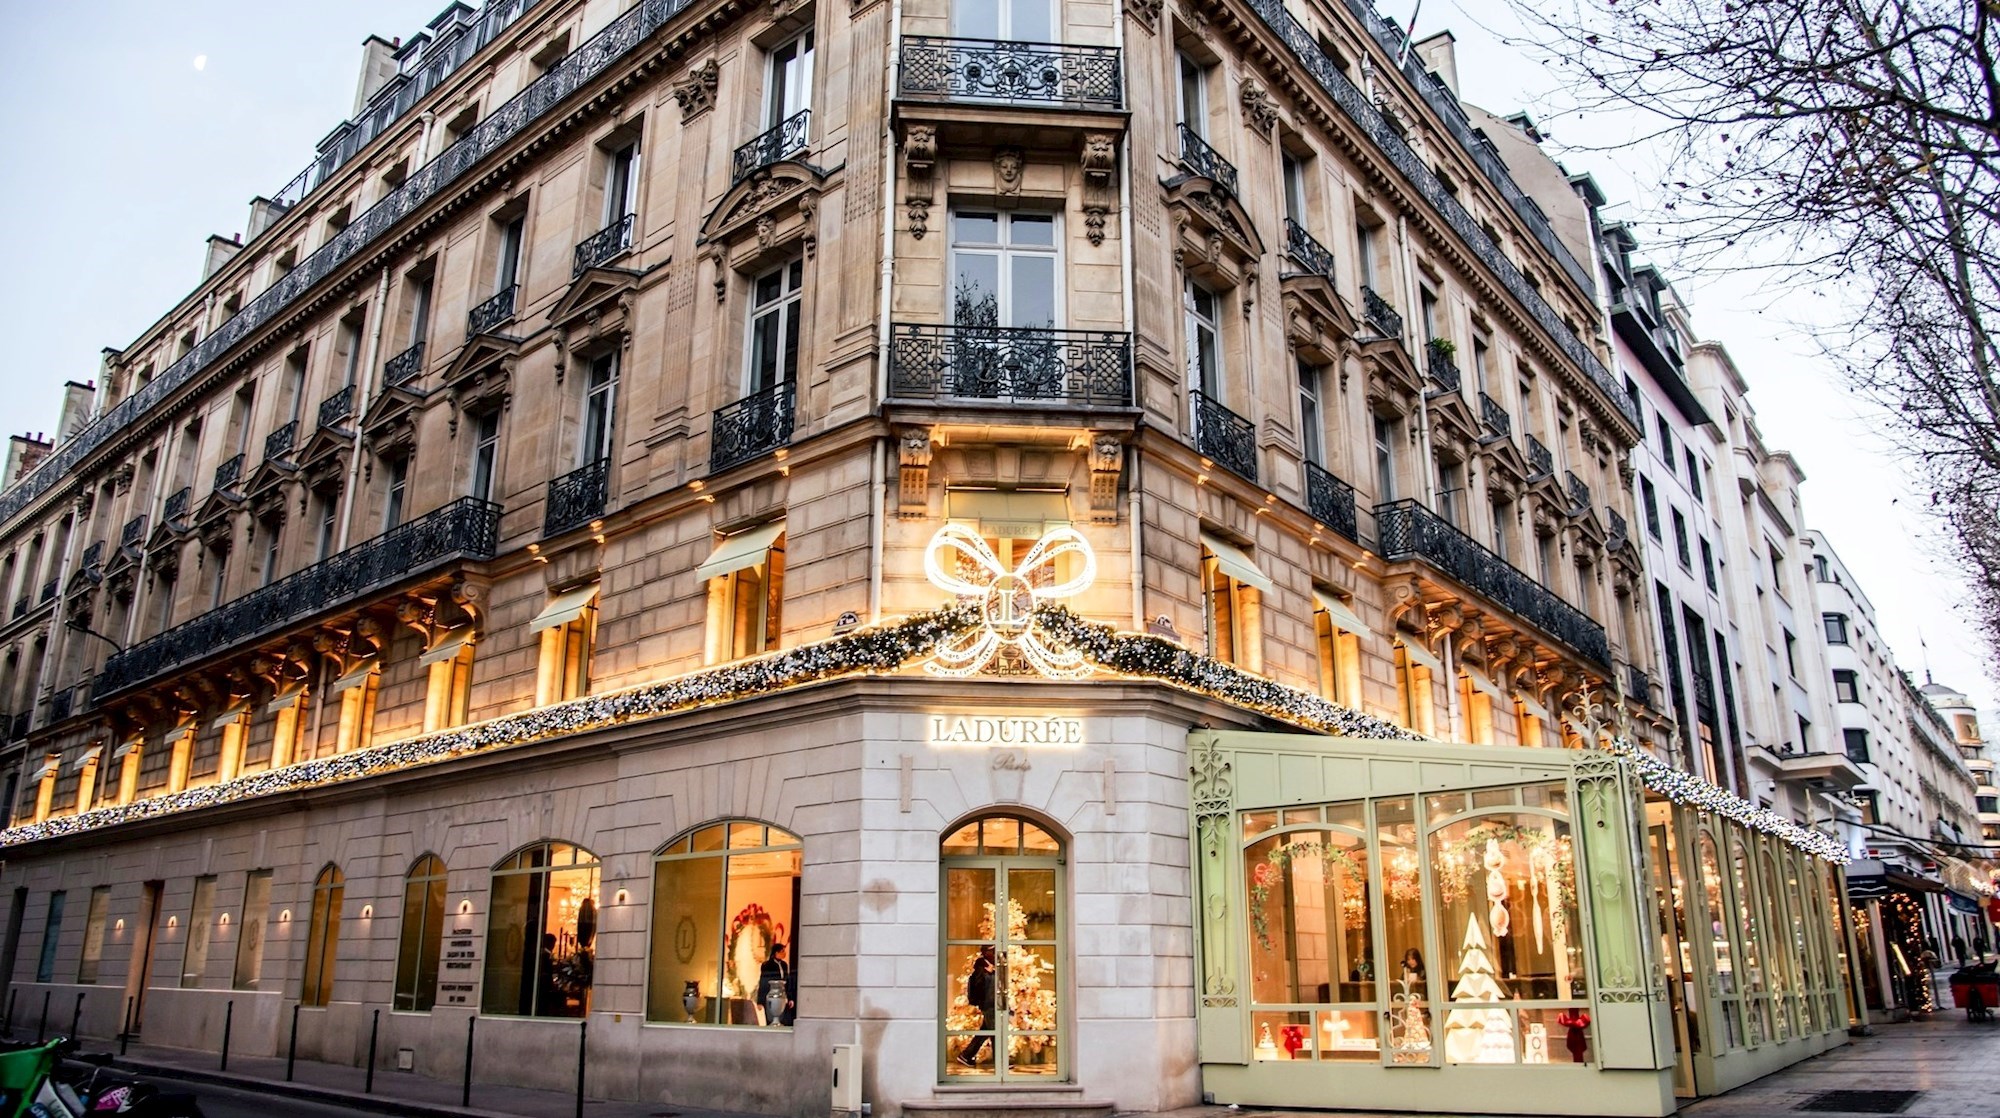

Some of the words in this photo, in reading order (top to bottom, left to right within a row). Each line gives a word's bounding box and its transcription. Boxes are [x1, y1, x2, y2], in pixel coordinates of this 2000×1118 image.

[994, 589, 1029, 624] L
[932, 717, 1082, 744] LADURÉE
[992, 752, 1032, 772] Paris
[681, 929, 691, 949] L
